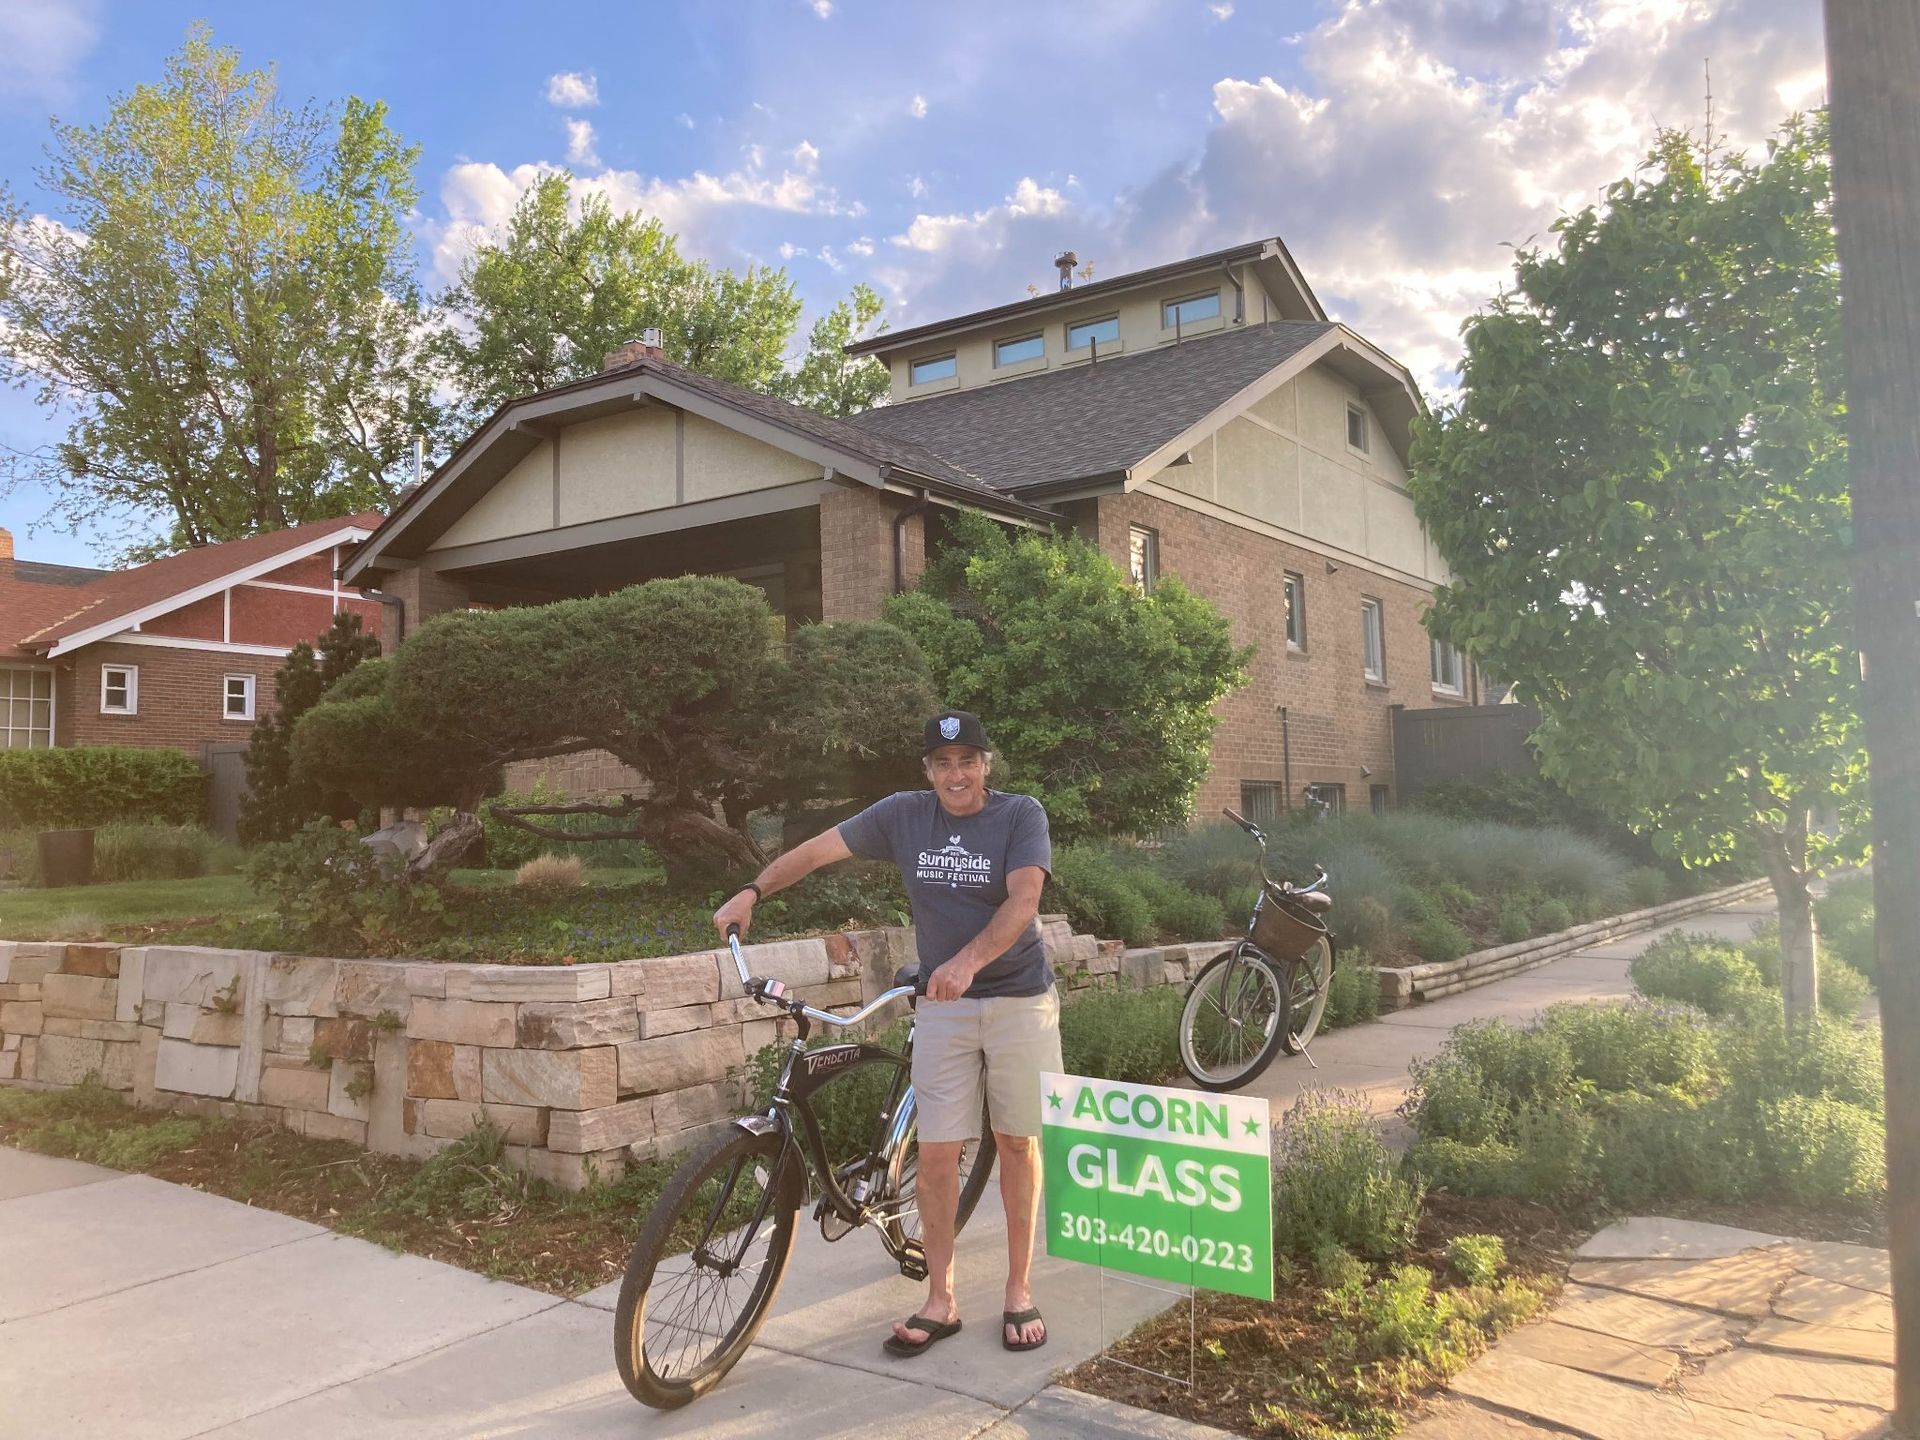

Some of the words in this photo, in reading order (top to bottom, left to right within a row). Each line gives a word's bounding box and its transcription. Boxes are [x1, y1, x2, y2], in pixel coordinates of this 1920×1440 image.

[916, 870, 944, 879] MUSIC
[947, 872, 991, 883] FESTIVAL
[918, 852, 991, 872] Sunnyside
[803, 1048, 861, 1075] VENDETTA
[1072, 1086, 1229, 1139] ACORN
[1067, 1143, 1242, 1213] GLASS
[1060, 1212, 1254, 1273] 303-420-0223
